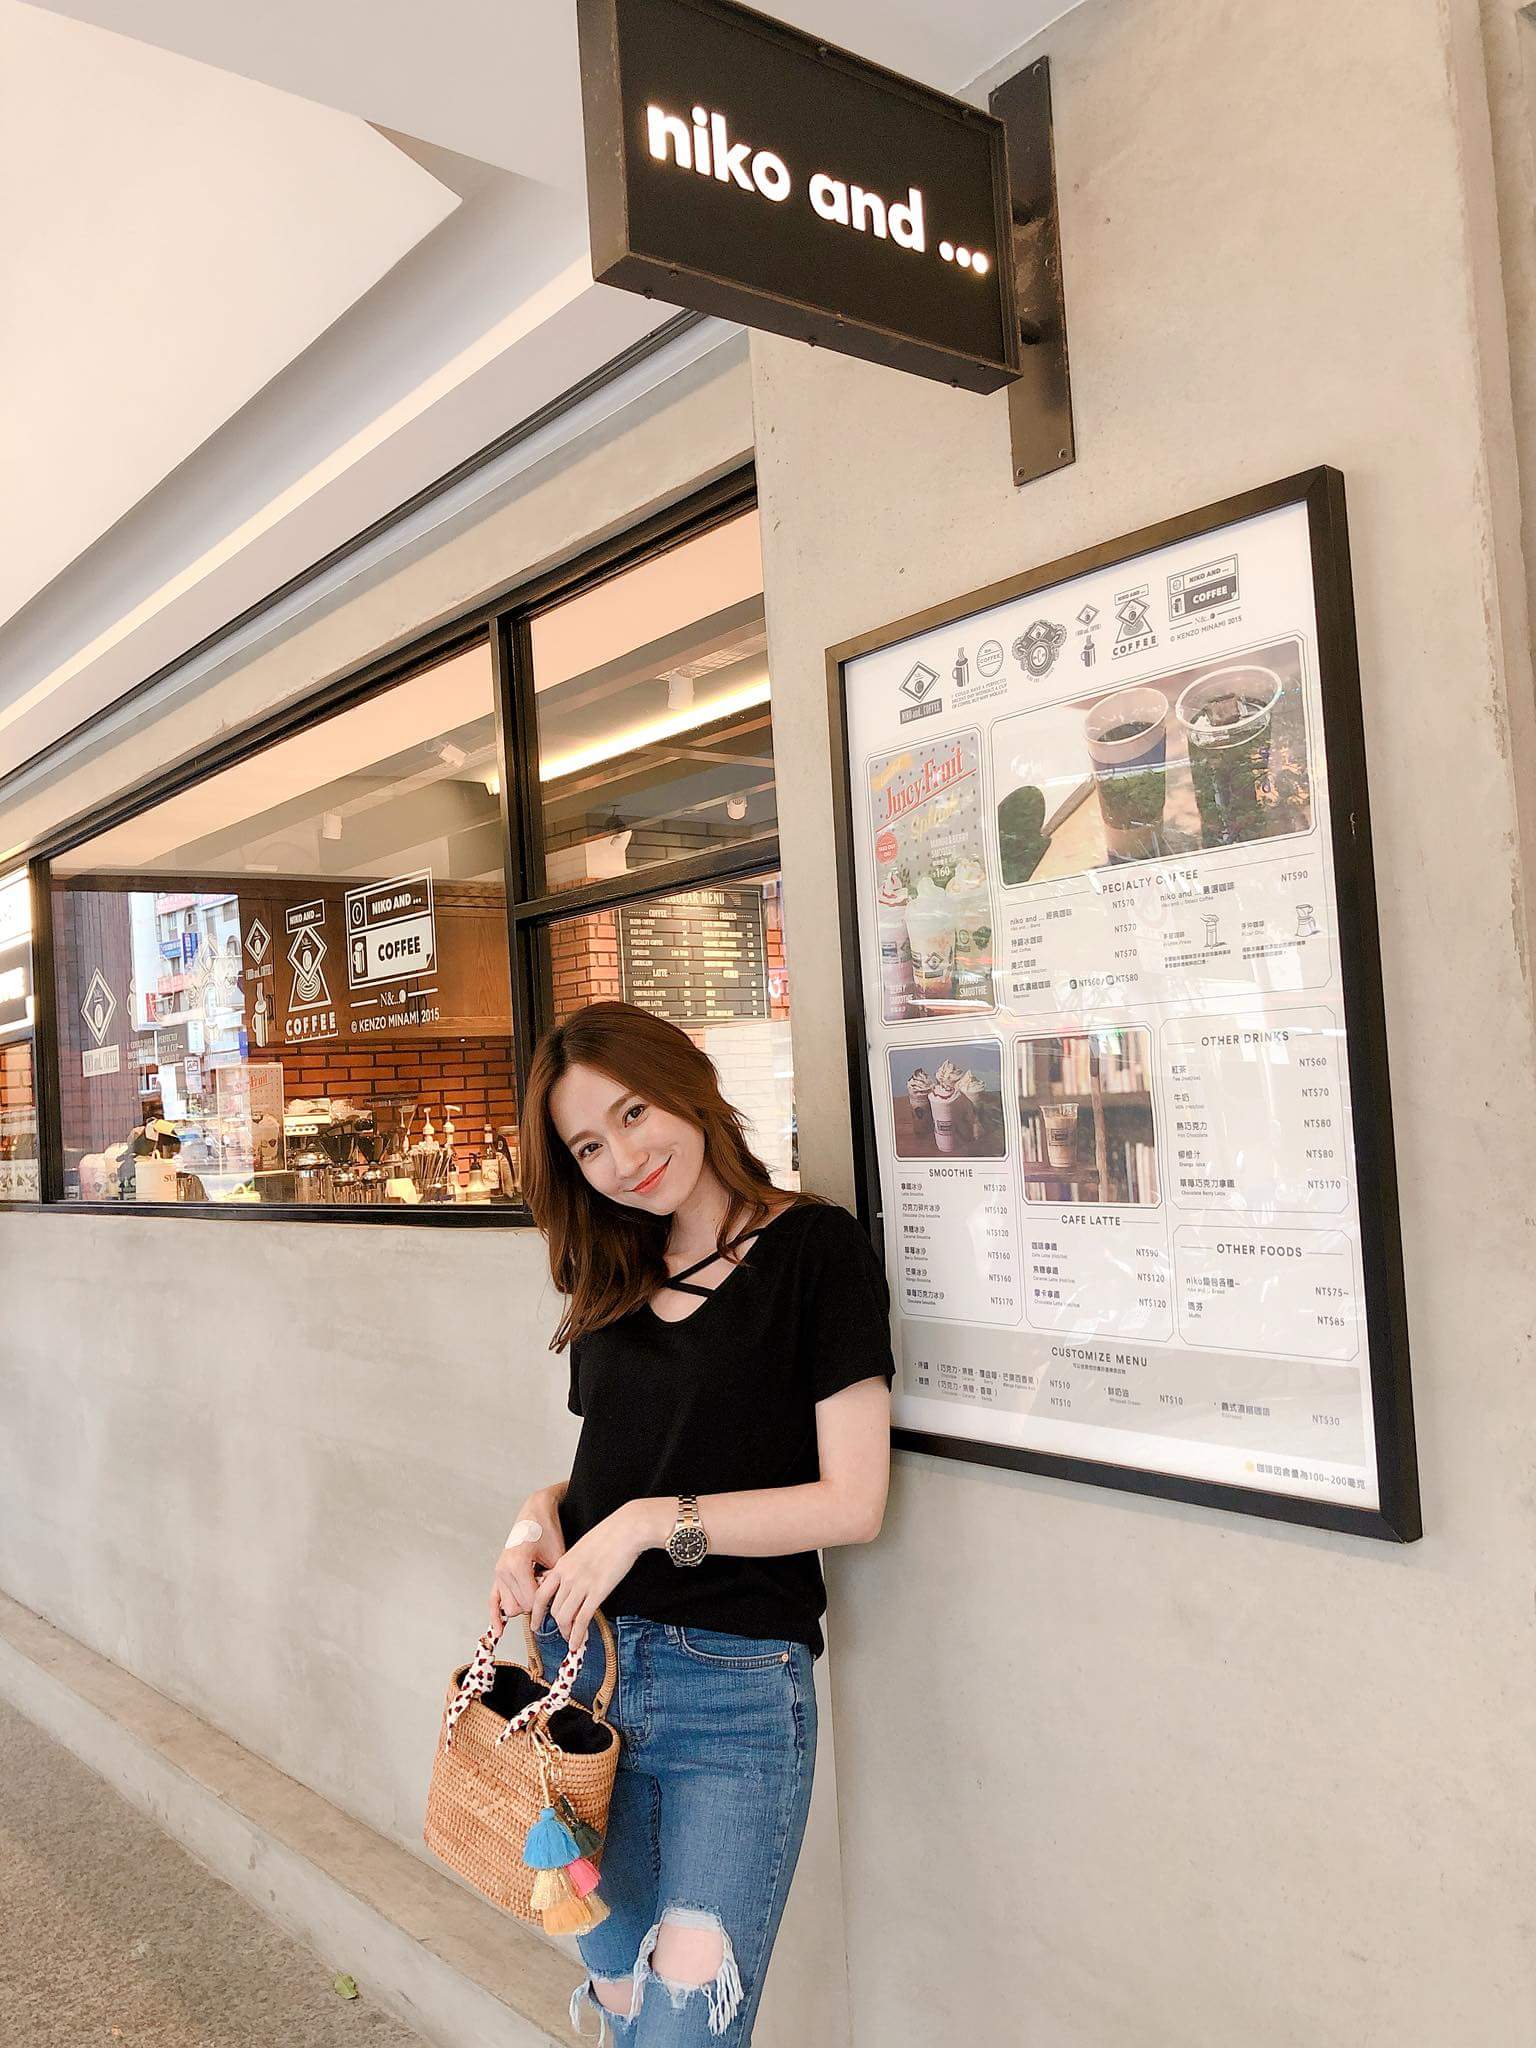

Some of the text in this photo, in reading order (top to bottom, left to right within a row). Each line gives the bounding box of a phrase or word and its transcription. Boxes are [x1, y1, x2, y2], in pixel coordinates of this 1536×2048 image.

[647, 104, 791, 202] niko
[808, 172, 926, 253] and
[1189, 574, 1206, 584] NIKO
[1206, 567, 1221, 578] AND
[1192, 585, 1228, 604] COFFEE
[1176, 628, 1200, 641] KENZO
[1200, 619, 1226, 634] MINAMI
[1227, 614, 1243, 626] 2015
[1112, 635, 1157, 657] COFFEE
[1281, 870, 1309, 883] NT$90
[1096, 877, 1152, 896] PECIALTY
[657, 892, 699, 905] EGULAR
[700, 892, 725, 905] MENU
[1178, 889, 1193, 900] and
[371, 899, 392, 917] NIKO
[393, 892, 411, 911] AND
[1112, 898, 1135, 910] NT$70
[289, 913, 303, 926] NIKO
[303, 909, 315, 922] AND
[1114, 923, 1137, 934] NT$70
[377, 935, 421, 962] COFFEE
[1114, 948, 1138, 960] NT$70
[285, 1010, 337, 1038] COFFEE
[359, 1016, 386, 1032] KENZO
[388, 1010, 419, 1030] MINAMI
[421, 1006, 440, 1024] 2015
[1201, 1030, 1290, 1047] OTHER DRINKS
[1298, 1057, 1327, 1068] NT$60
[1173, 1093, 1190, 1102] 牛奶
[1301, 1087, 1330, 1098] NT$70
[1176, 1121, 1208, 1131] 熱巧克力
[1303, 1118, 1332, 1129] NT$80
[1305, 1149, 1334, 1160] NT$80
[928, 1168, 974, 1178] SMOOTHIE
[983, 1184, 1007, 1192] NT$120
[1307, 1179, 1341, 1190] NT$170
[984, 1206, 1008, 1215] NT$120
[1061, 1214, 1121, 1226] CAFE LATTE
[986, 1229, 1009, 1237] NT$120
[987, 1251, 1011, 1260] NT$160
[1136, 1248, 1159, 1258] NT$90
[1216, 1243, 1302, 1258] OTHER FOODS
[988, 1274, 1012, 1283] NT$160
[1137, 1273, 1165, 1283] NT$120
[990, 1297, 1014, 1306] NT$170
[1138, 1298, 1167, 1309] NT$120
[1317, 1315, 1345, 1327] NT$85
[1051, 1347, 1148, 1367] CUSTOMIZE MENU
[1049, 1379, 1071, 1390] NT$10
[1050, 1397, 1071, 1408] NT$10
[1159, 1394, 1183, 1406] NT$10
[1312, 1414, 1340, 1427] NT$30
